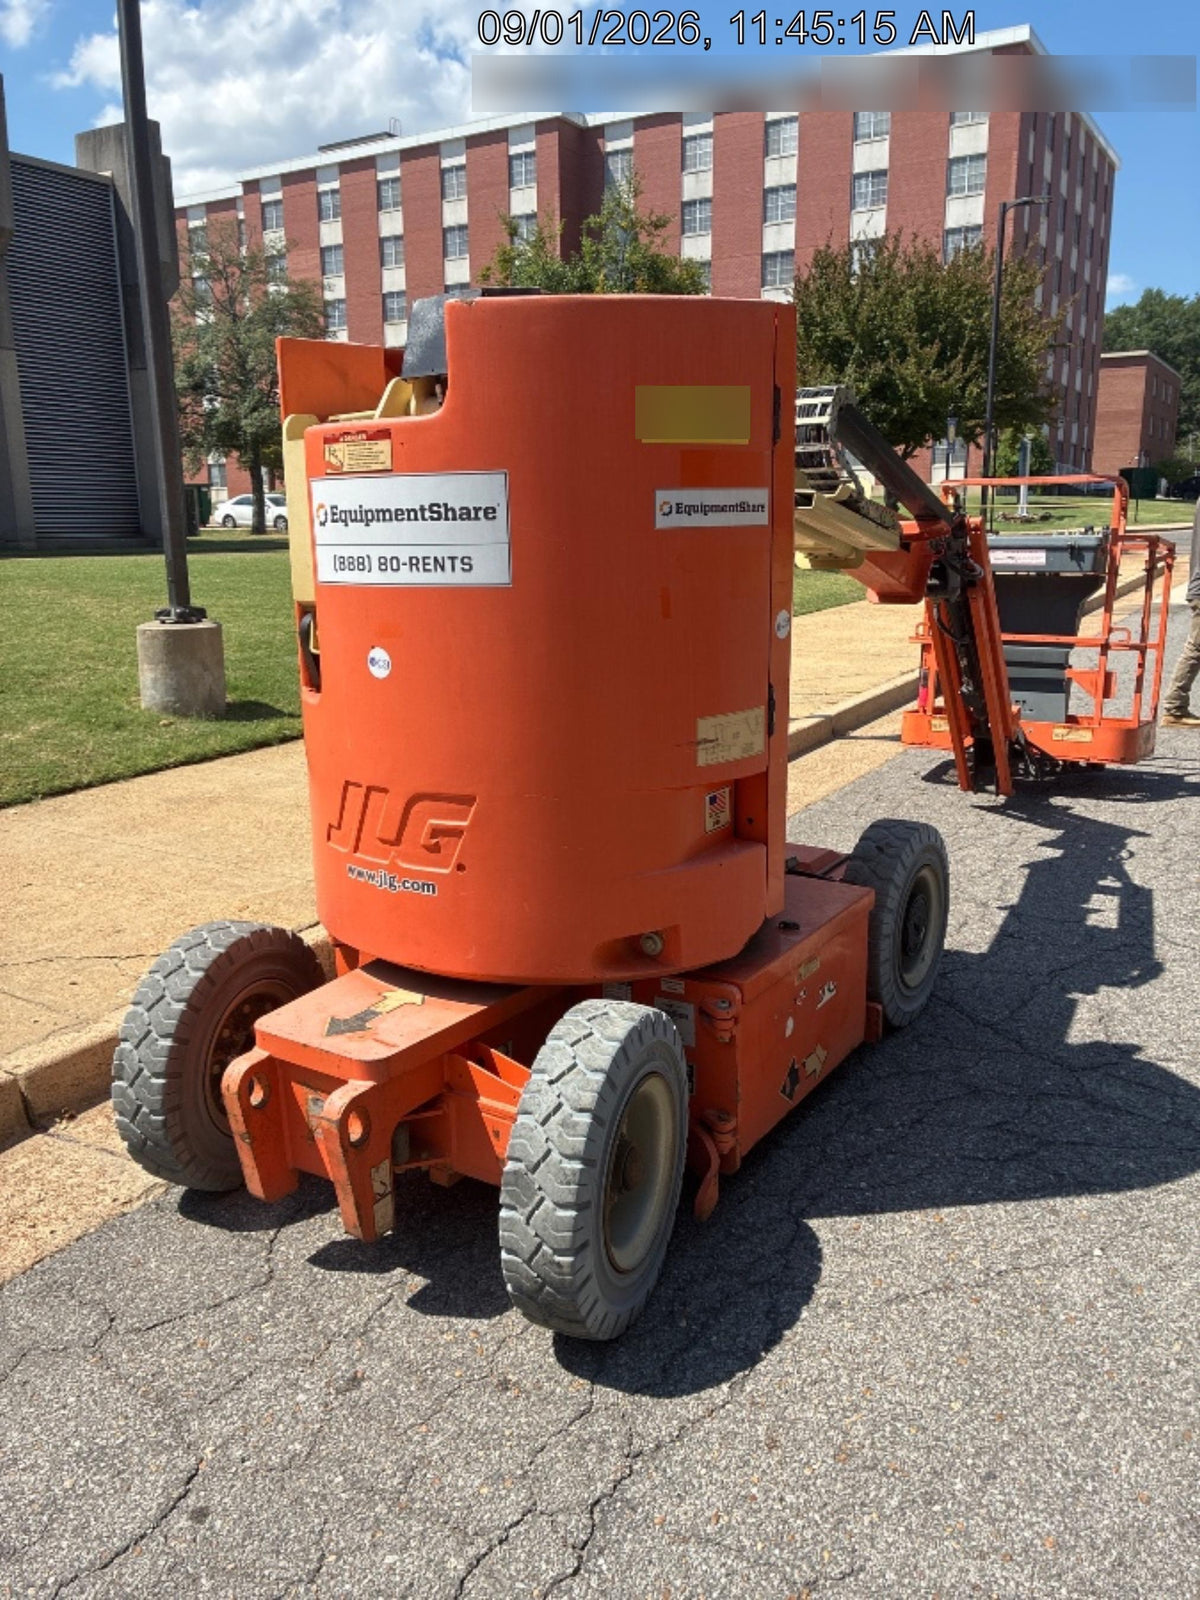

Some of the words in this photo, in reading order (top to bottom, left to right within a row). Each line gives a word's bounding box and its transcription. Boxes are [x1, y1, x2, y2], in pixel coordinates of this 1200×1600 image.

[330, 502, 498, 527] EquipmentShare
[675, 501, 766, 516] EquipmentShare
[333, 554, 373, 573] (888)
[378, 556, 474, 574] 80-RENTS
[327, 780, 478, 874] JLG
[347, 865, 437, 895] www.jlg.com
